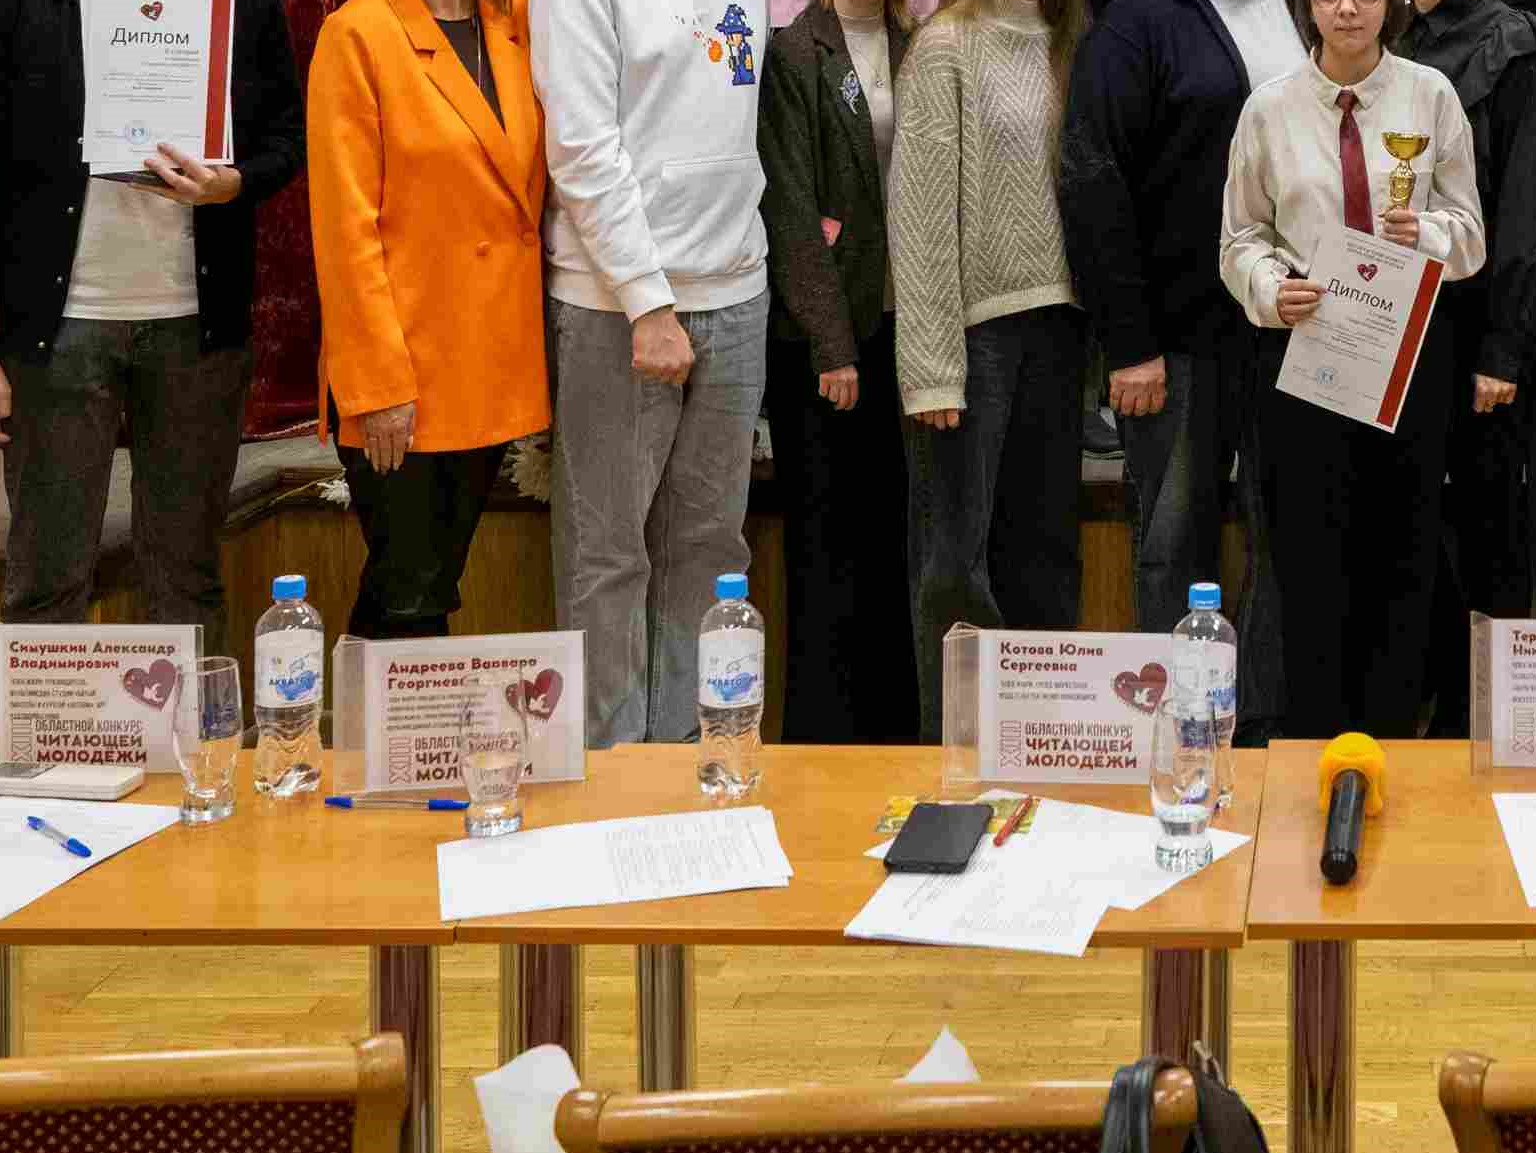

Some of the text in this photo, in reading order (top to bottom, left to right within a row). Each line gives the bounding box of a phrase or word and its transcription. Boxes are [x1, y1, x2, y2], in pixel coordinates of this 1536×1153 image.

[110, 27, 190, 46] Диплом
[1328, 278, 1394, 313] Диплом
[92, 641, 176, 656] Александр
[1000, 642, 1103, 656] Котова Юлия
[9, 656, 120, 670] Владимирович
[388, 661, 466, 676] Андреева
[1000, 658, 1078, 673] Сергеевна
[388, 677, 479, 691] Георгиев
[35, 718, 142, 733] ОБЛАСТНОЙ КОНКУРС
[1086, 723, 1133, 738] КОНКУРС
[36, 734, 142, 748] ЧИТАЮЩЕЙ
[1026, 738, 1133, 753] ЧИТАЮЩЕЙ
